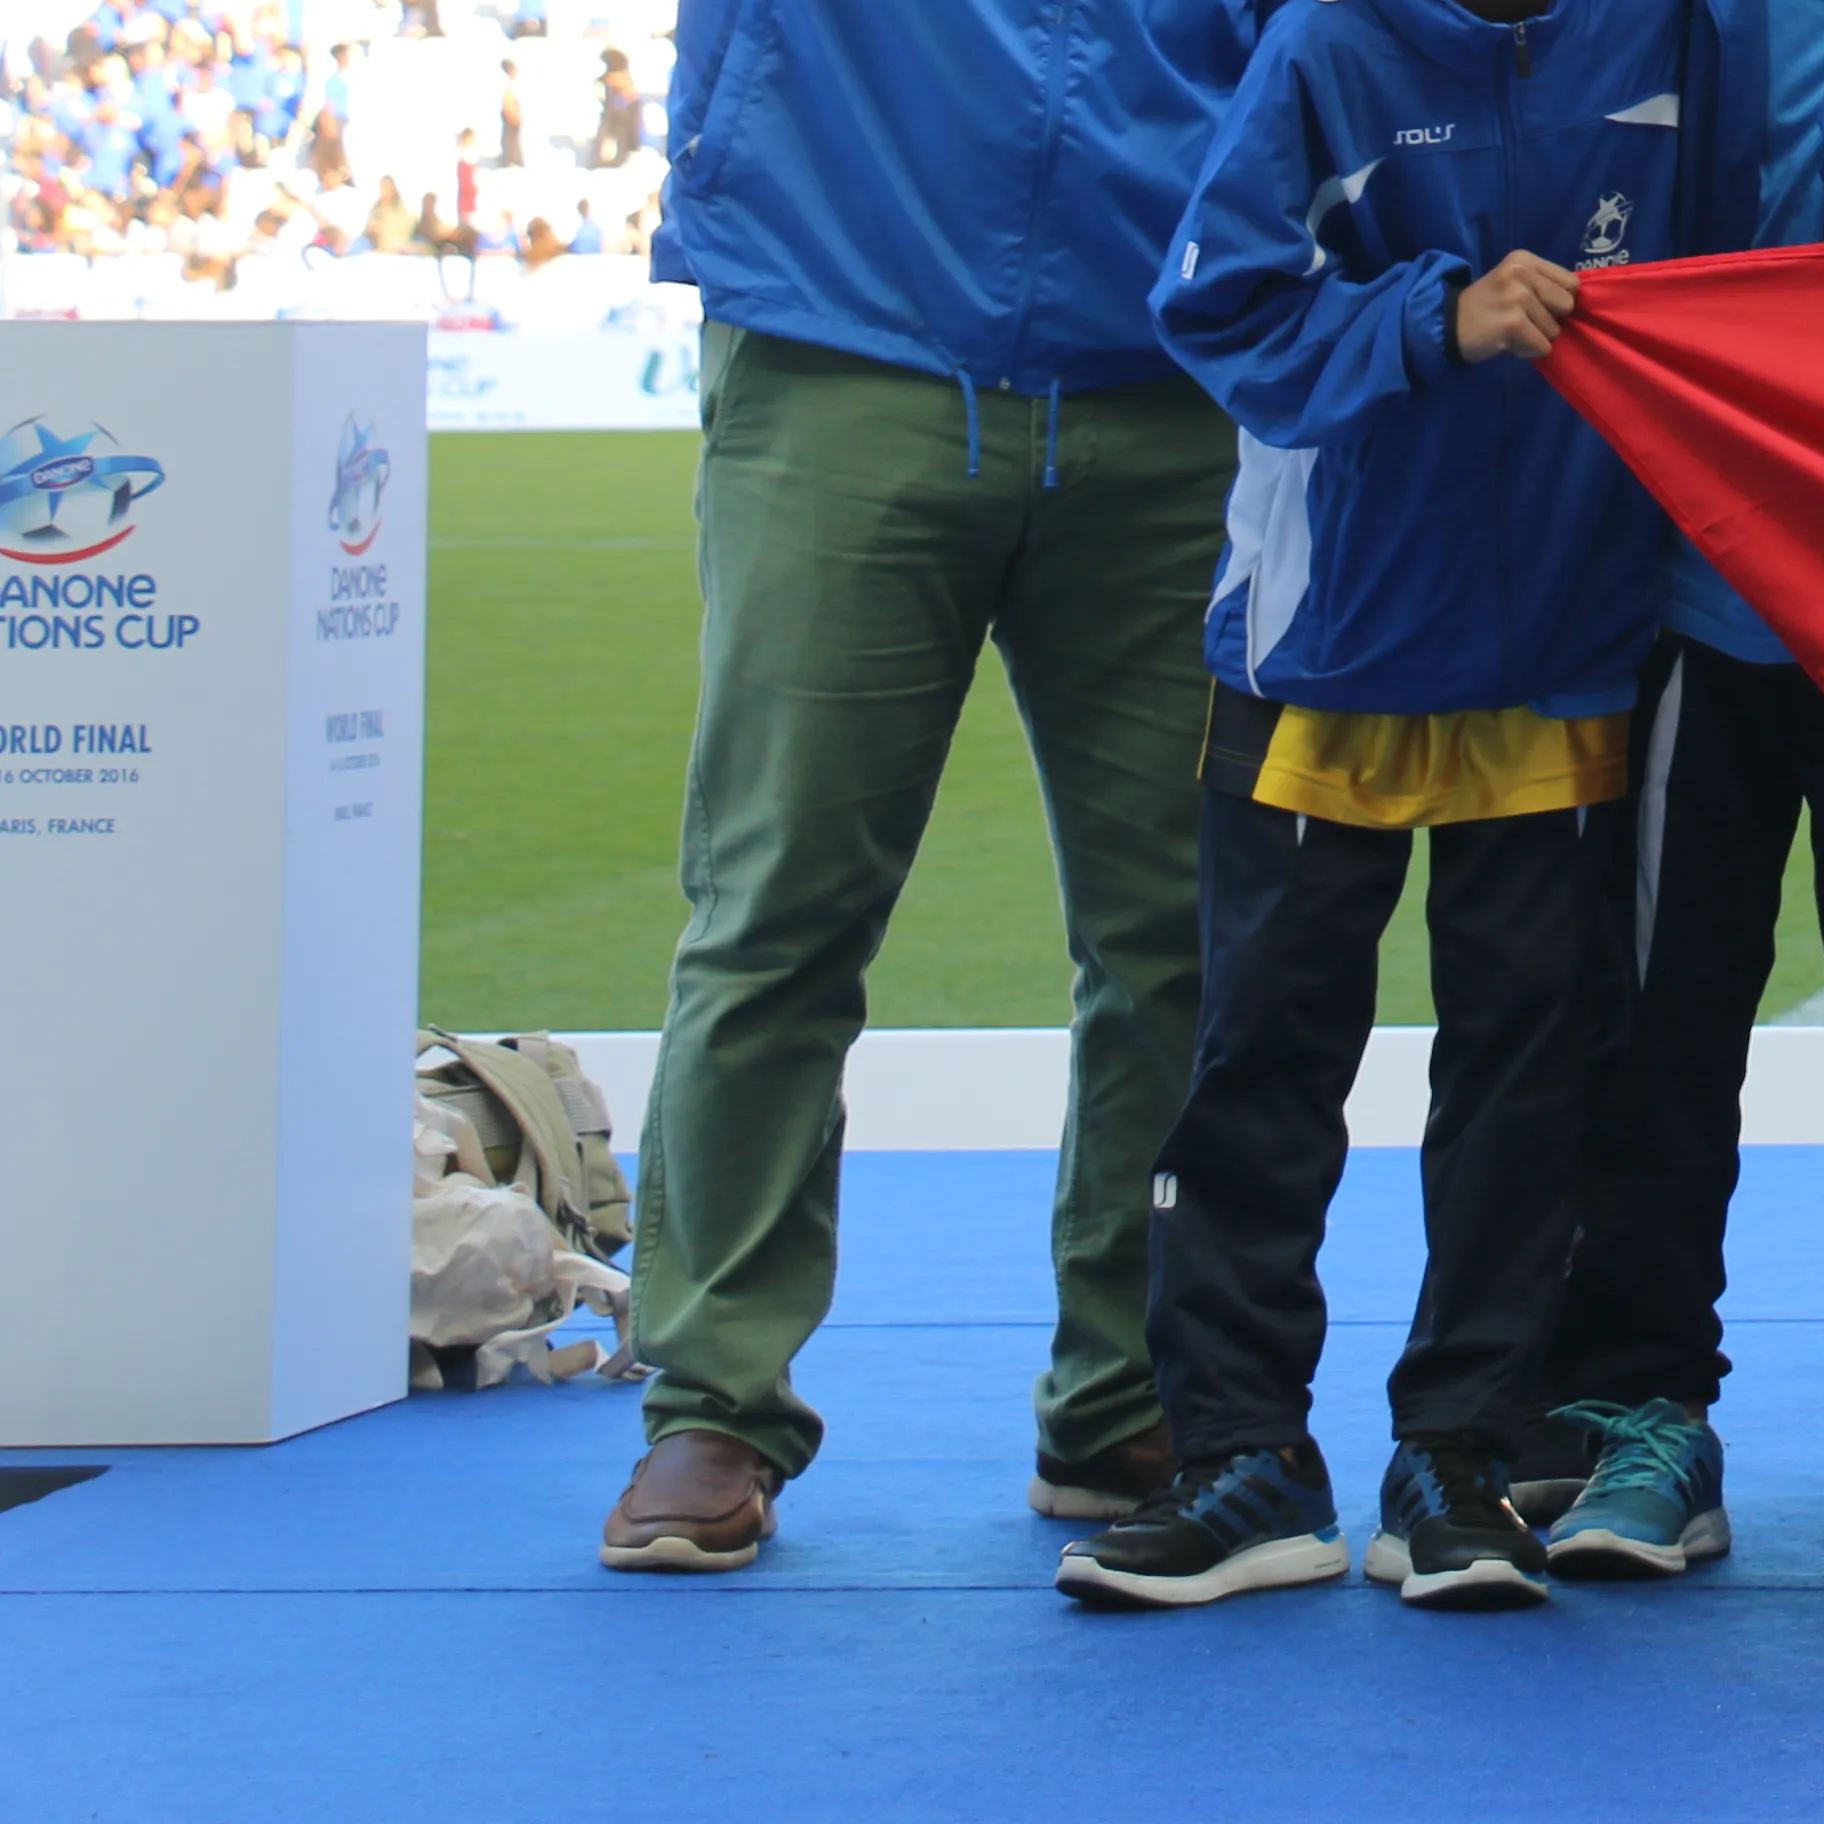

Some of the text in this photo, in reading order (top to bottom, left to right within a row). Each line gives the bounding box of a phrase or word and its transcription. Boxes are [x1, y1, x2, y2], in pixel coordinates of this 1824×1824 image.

[0, 573, 157, 609] ANONe
[0, 614, 201, 650] IONS CUP
[0, 724, 152, 754] RLD FINAL
[19, 769, 94, 784] OCTOBER
[100, 769, 140, 784] 2016
[0, 819, 116, 837] ARIS, FRANCE
